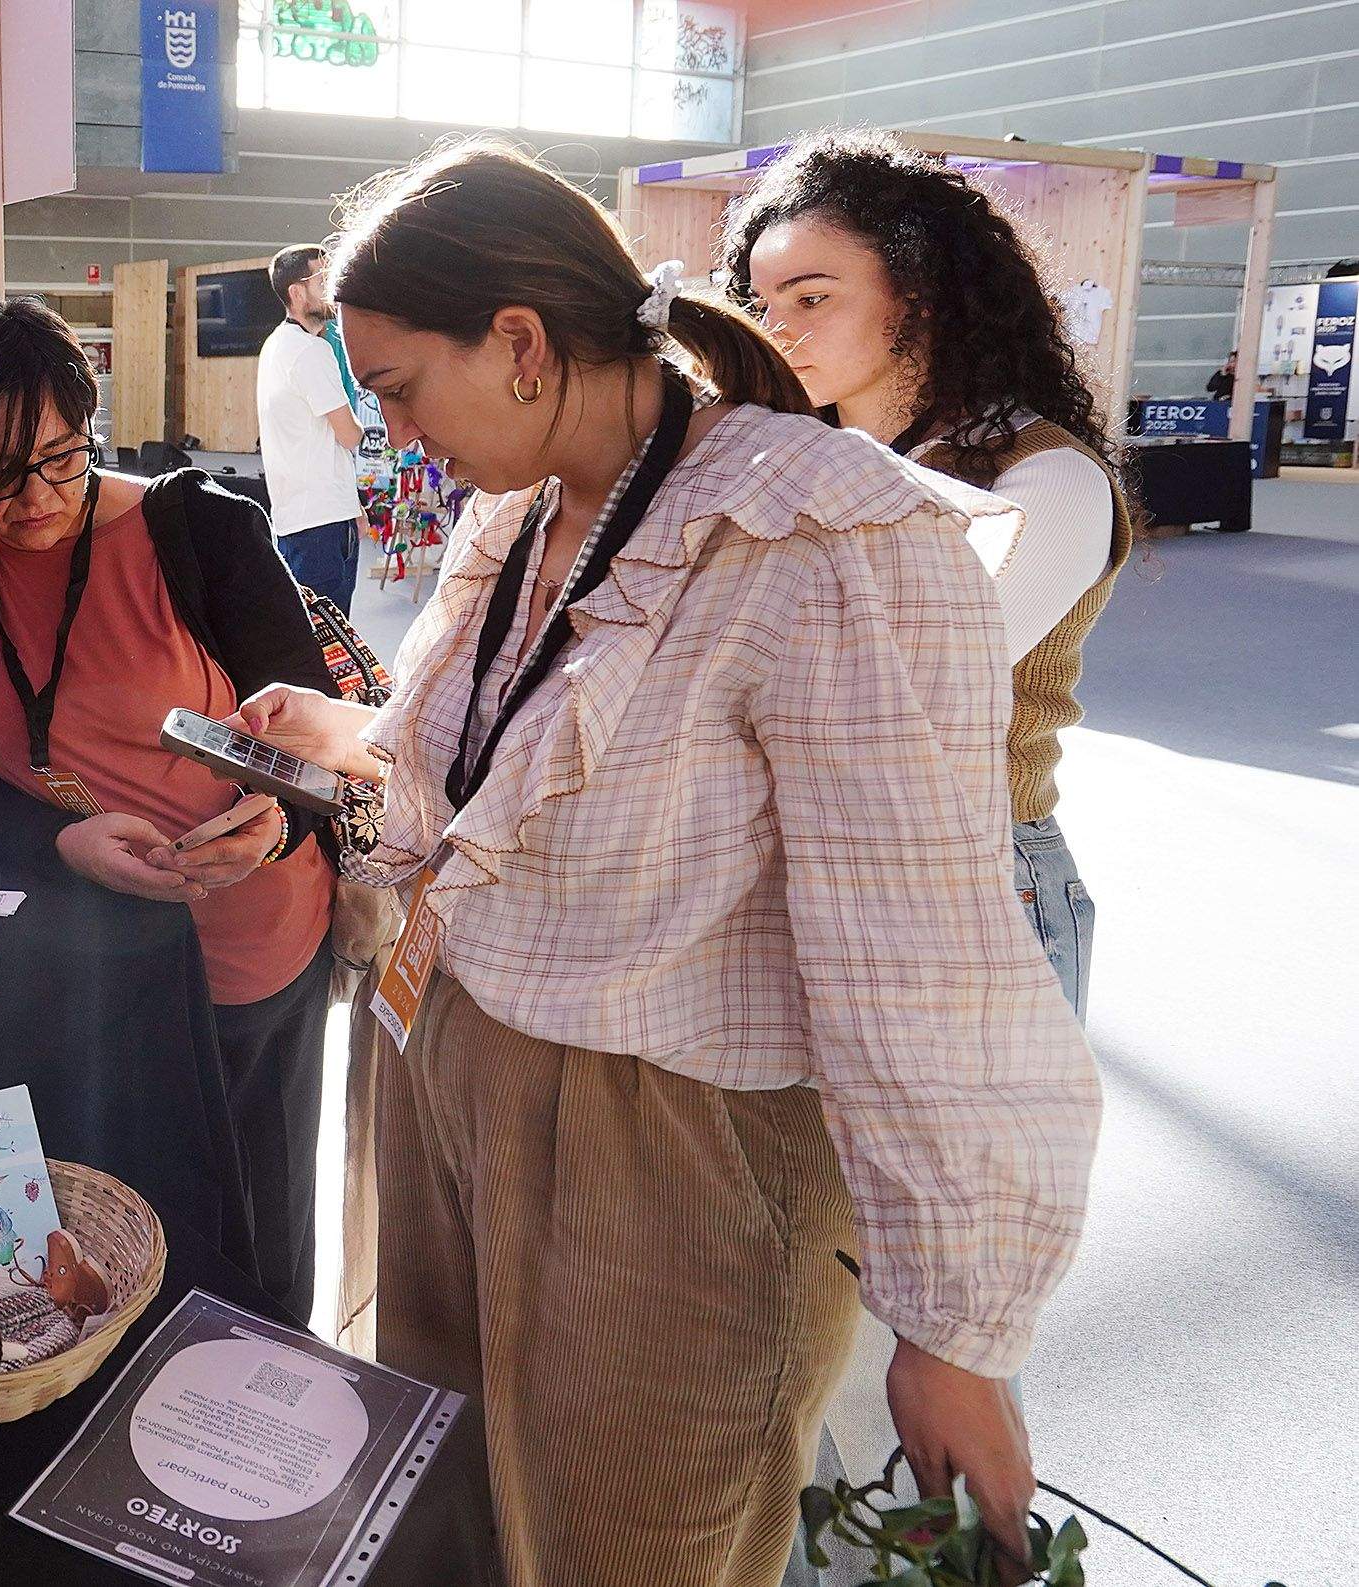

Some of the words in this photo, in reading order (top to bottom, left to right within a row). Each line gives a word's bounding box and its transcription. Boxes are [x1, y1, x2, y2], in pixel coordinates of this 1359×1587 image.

[157, 81, 167, 89] de
[1316, 316, 1355, 327] FEROZ
[1145, 406, 1208, 421] FEROZ
[1145, 420, 1177, 430] 2025
[158, 1458, 226, 1489] participar?
[229, 1488, 270, 1508] Como
[75, 1505, 113, 1524] GRAN
[117, 1524, 156, 1543] NOSO
[160, 1541, 182, 1554] NO
[187, 1553, 261, 1585] PARTICIPA
